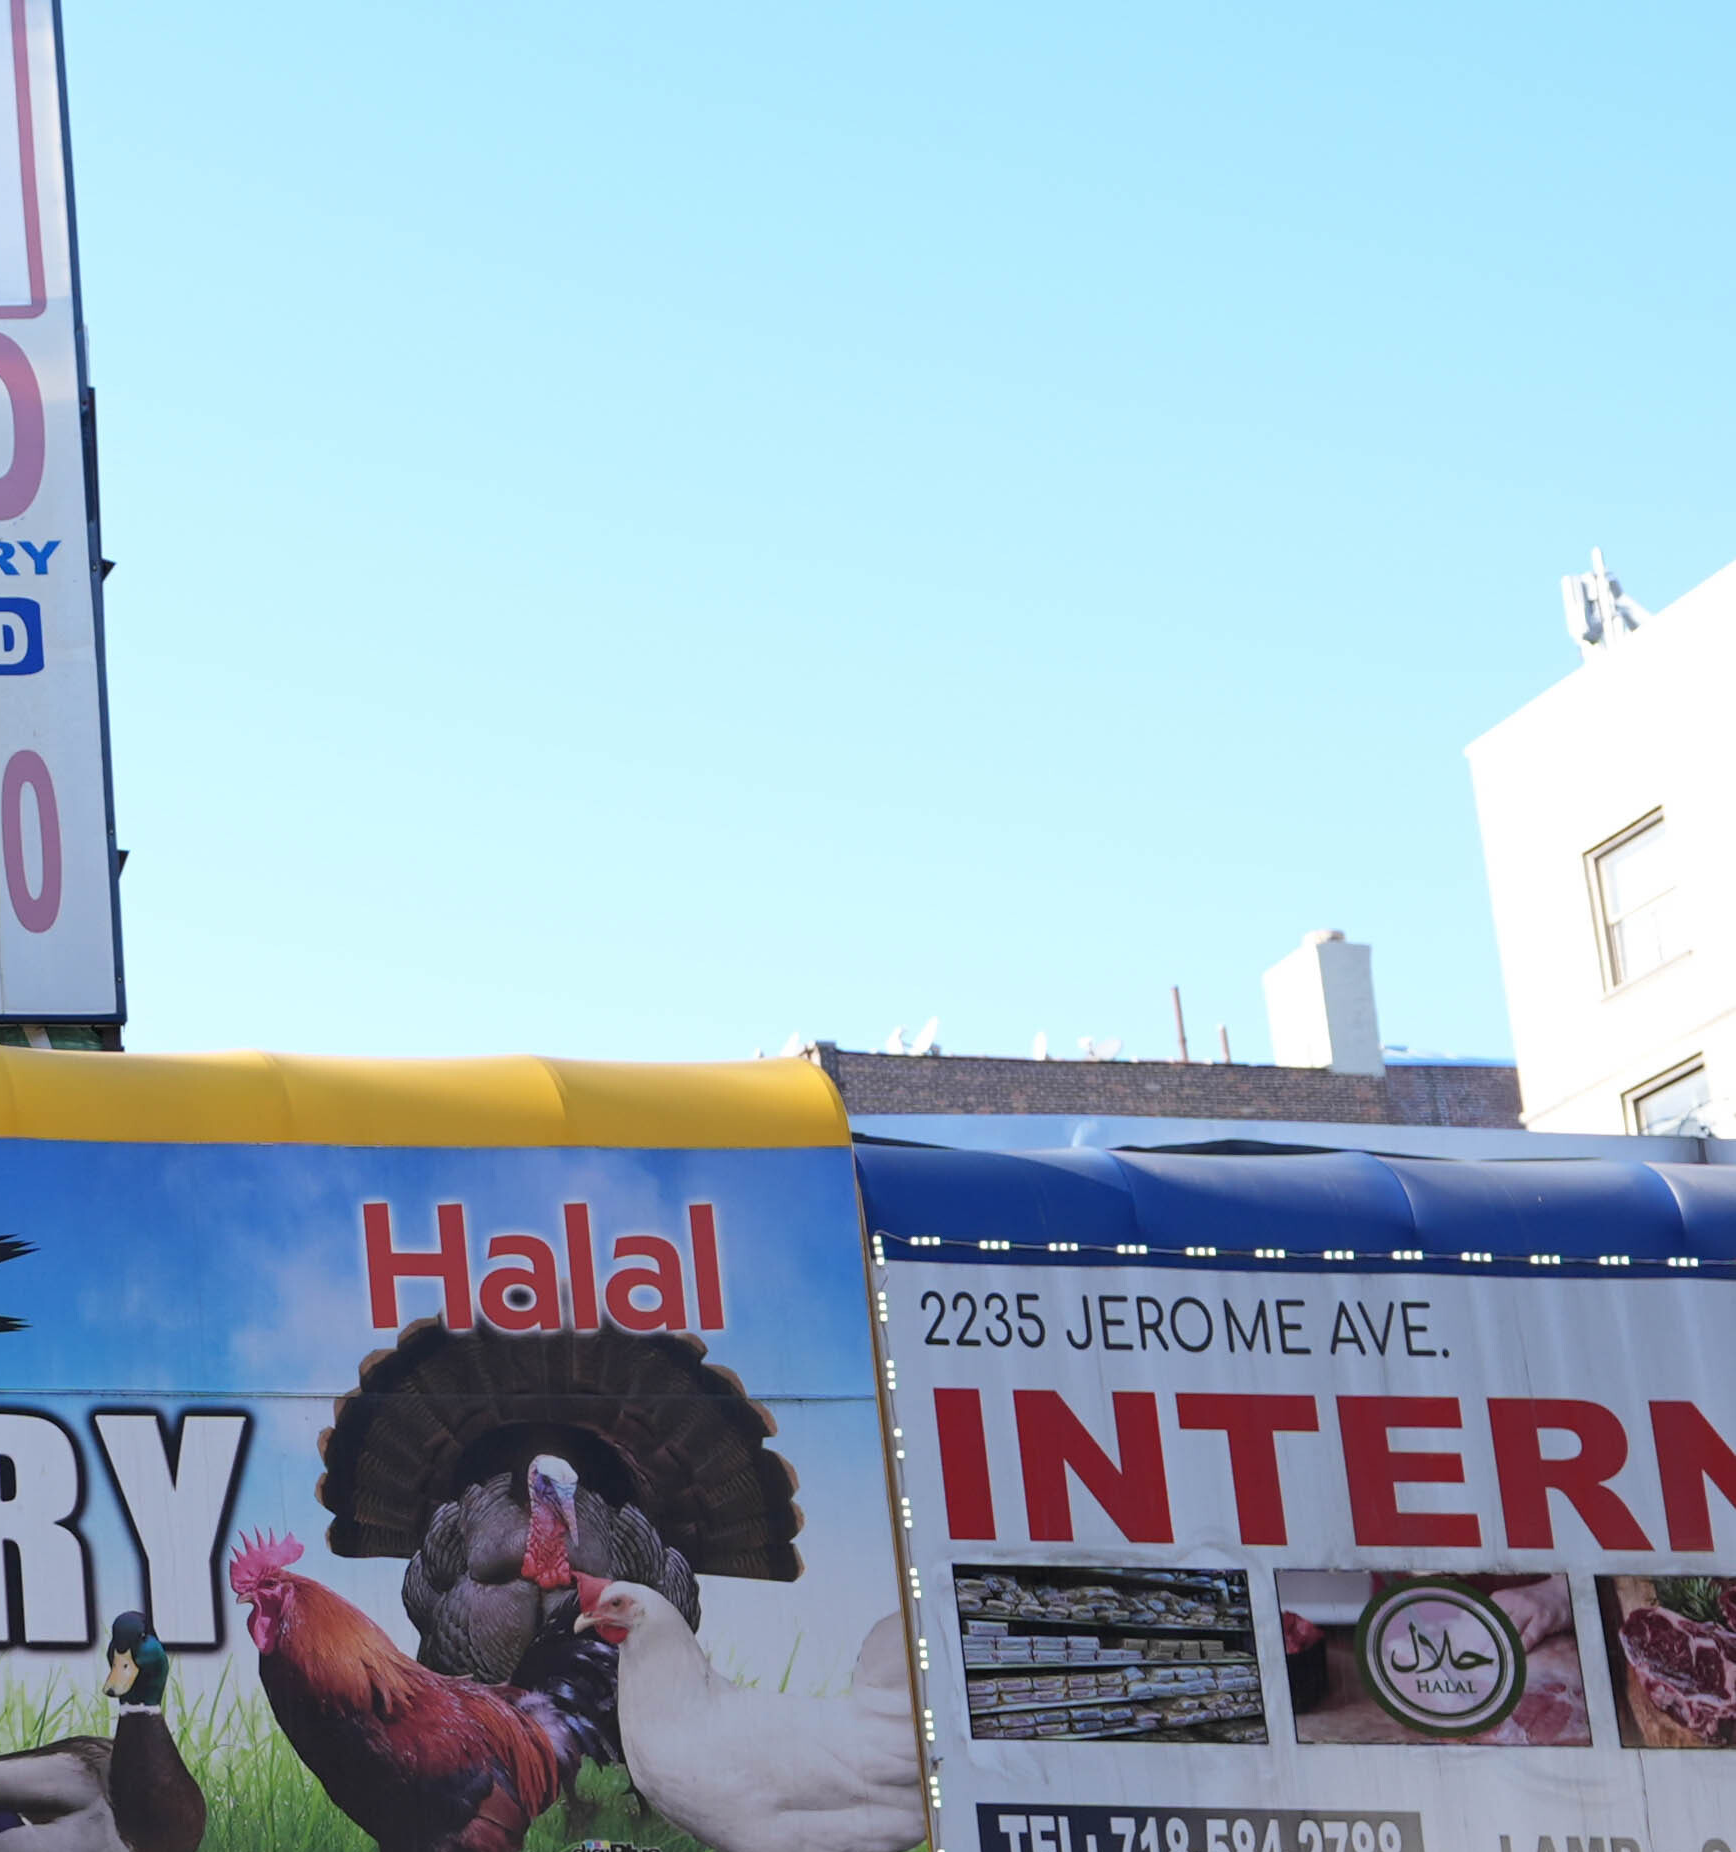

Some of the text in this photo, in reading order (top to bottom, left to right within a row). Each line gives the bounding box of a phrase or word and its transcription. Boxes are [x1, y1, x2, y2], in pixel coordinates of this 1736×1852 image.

[362, 1202, 725, 1332] Halal
[920, 1290, 1452, 1359] 2235 JEROME AVE.
[1390, 1621, 1495, 1674] حلال
[1415, 1680, 1478, 1695] HALAL
